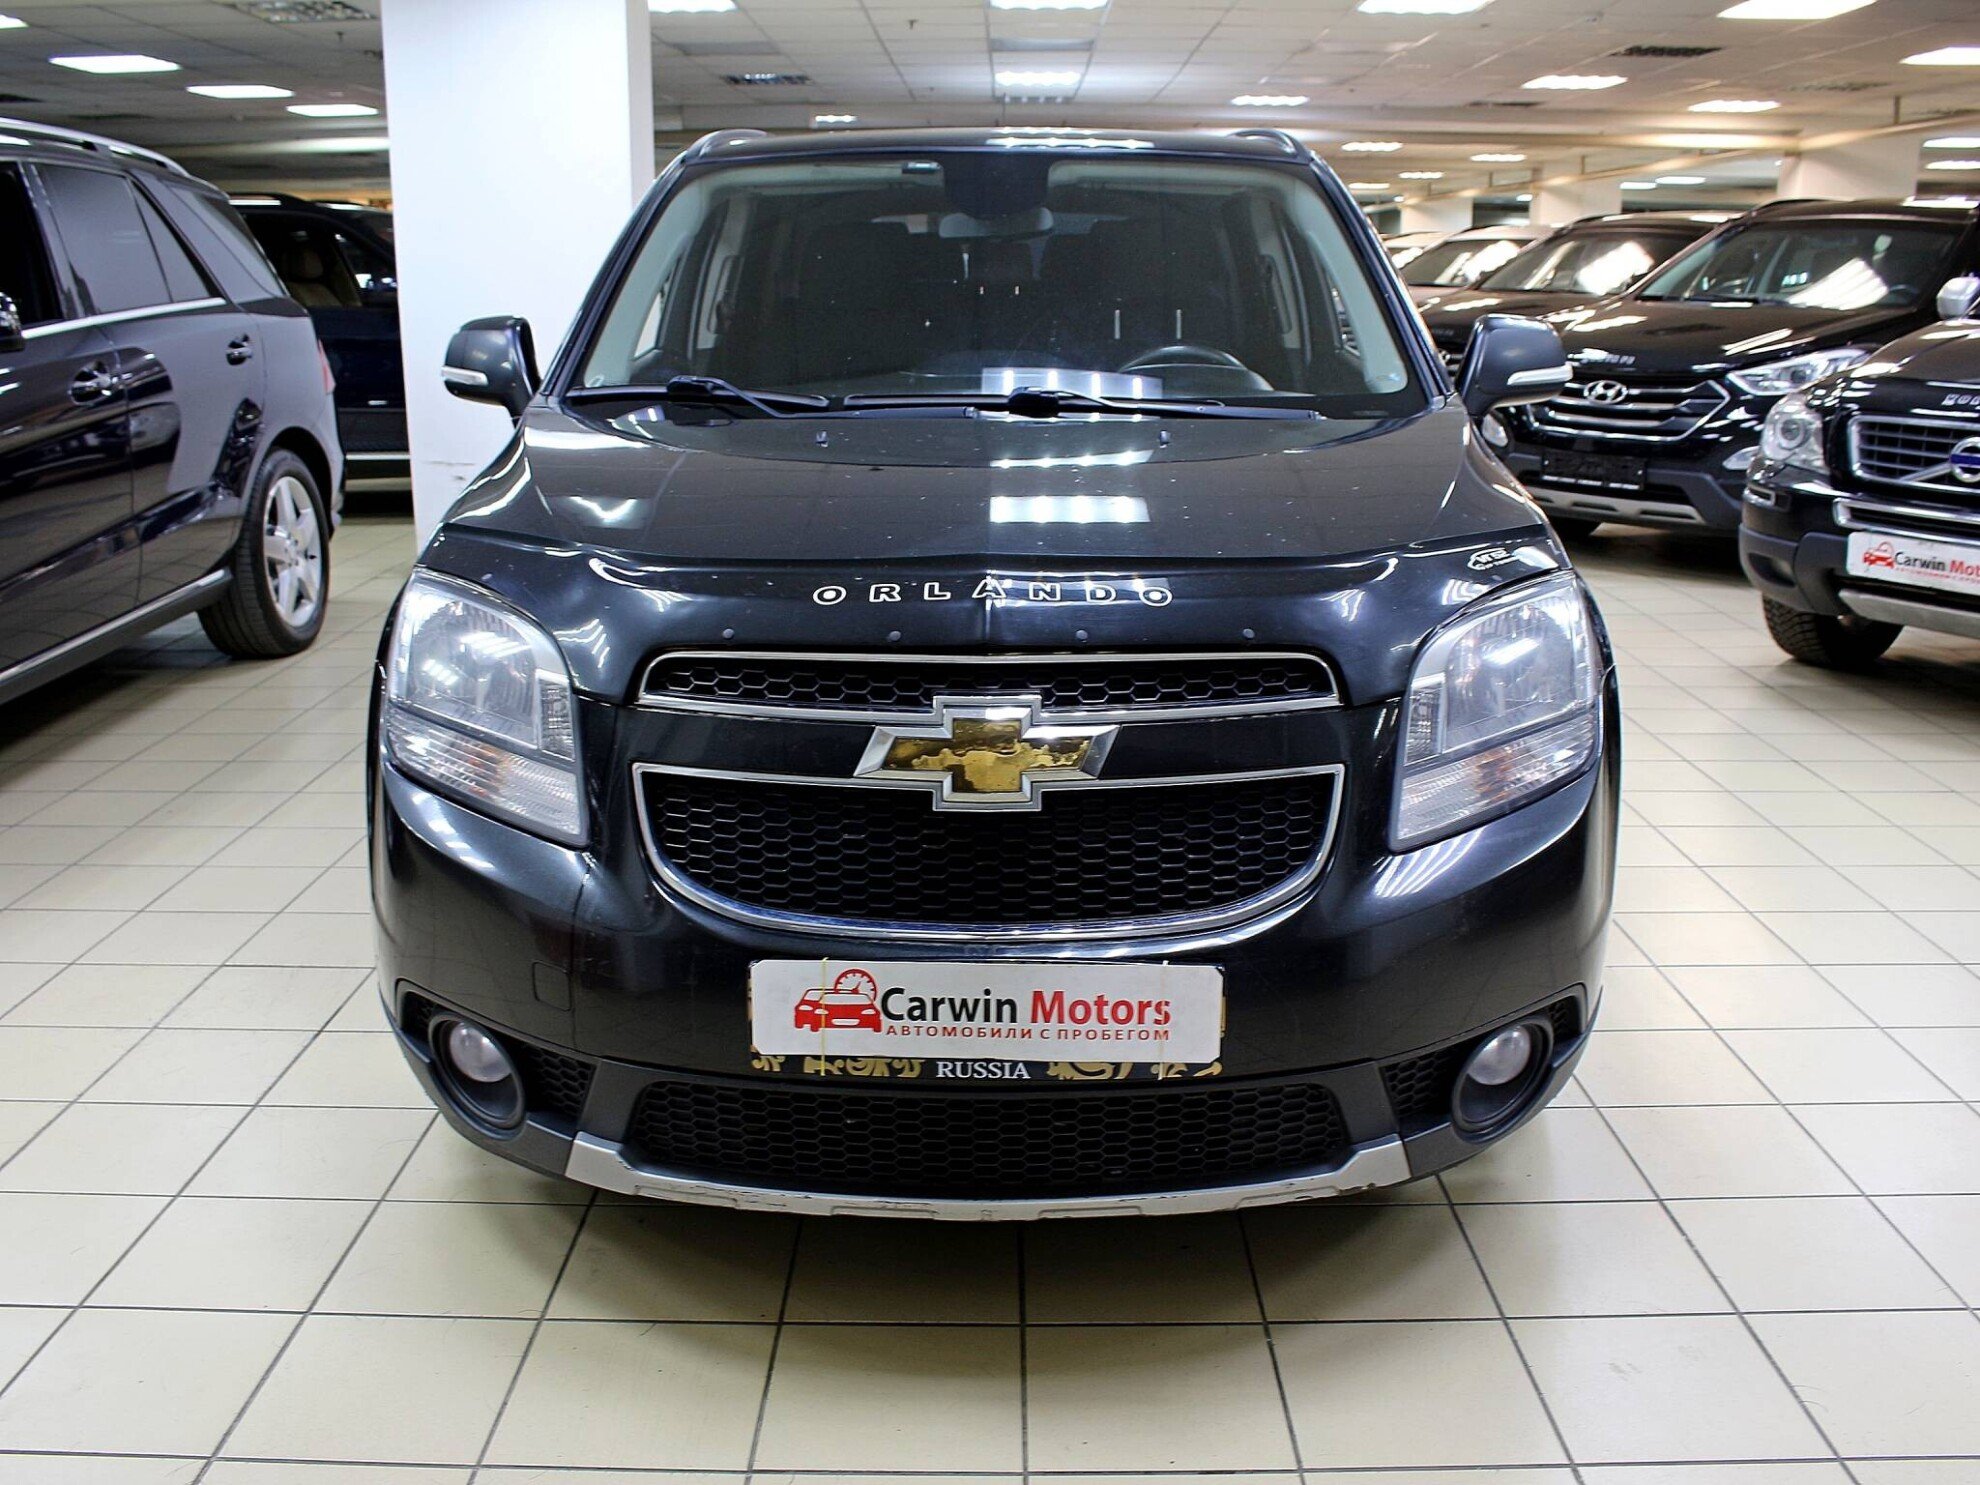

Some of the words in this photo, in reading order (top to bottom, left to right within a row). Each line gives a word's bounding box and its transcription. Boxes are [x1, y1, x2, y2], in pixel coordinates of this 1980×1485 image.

[1894, 551, 1946, 572] Carwin
[812, 577, 1173, 607] ORLANDO
[880, 987, 1018, 1024] Carwin
[1030, 989, 1172, 1026] Motors
[886, 1025, 1032, 1039] АВТОМОБИЛИ
[1040, 1028, 1050, 1040] С
[1057, 1028, 1170, 1041] ПРОБЕГОМ
[935, 1061, 1031, 1080] RUSSIA
